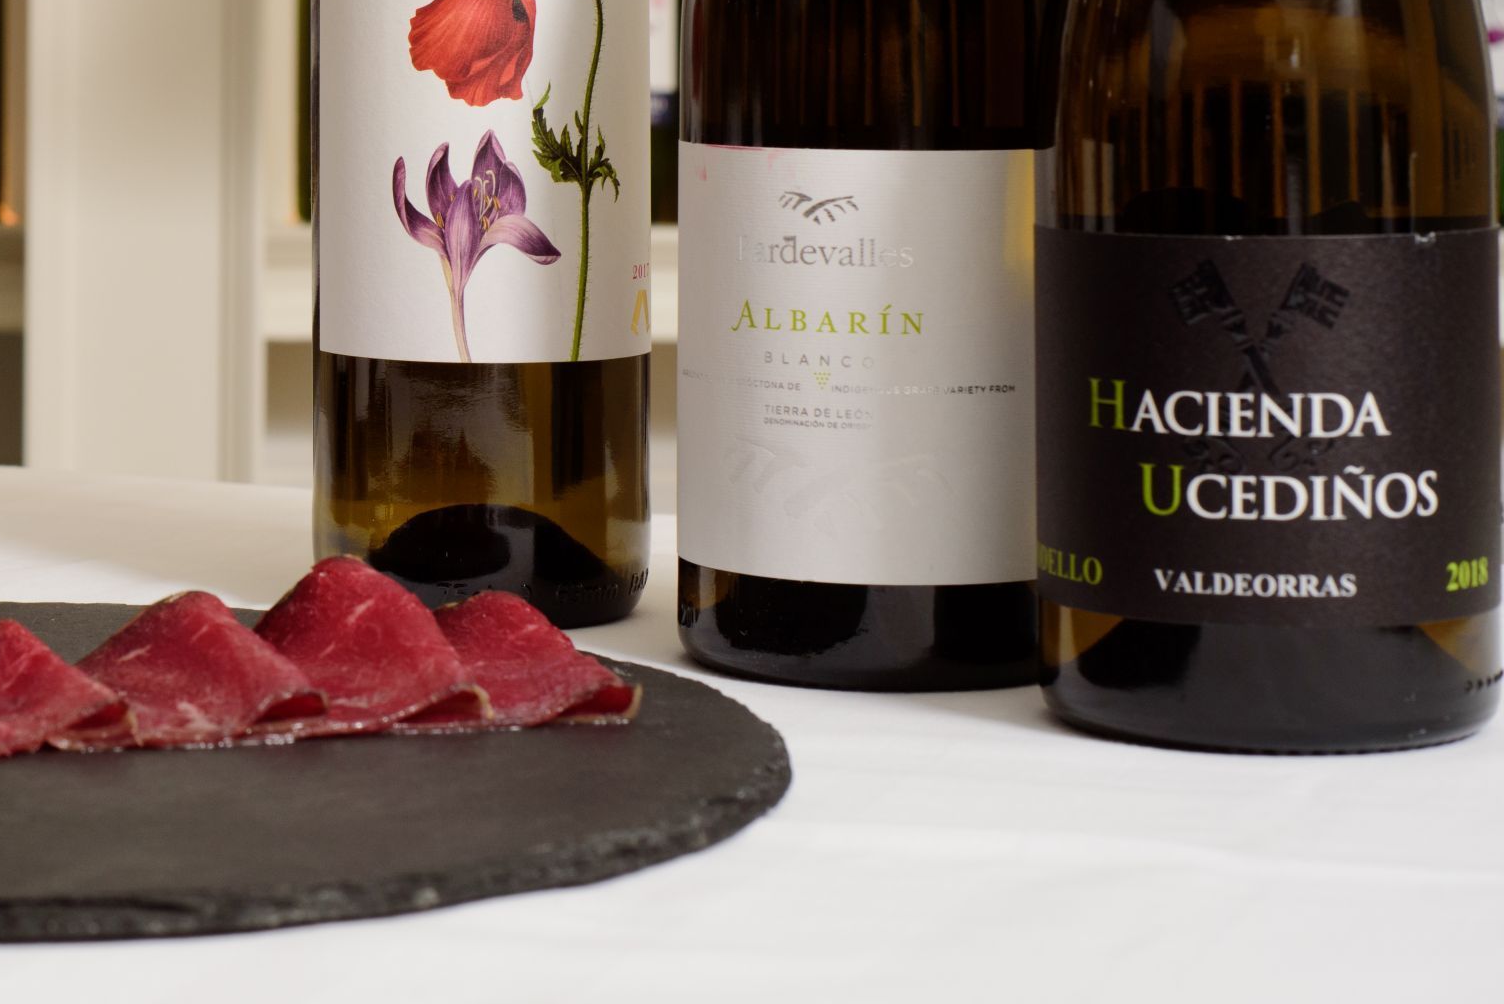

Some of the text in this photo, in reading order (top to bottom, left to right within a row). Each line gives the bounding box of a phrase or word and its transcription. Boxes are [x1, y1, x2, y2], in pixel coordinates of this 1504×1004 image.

[731, 299, 925, 336] ALBARÍN
[763, 350, 875, 370] BLANCO
[943, 385, 986, 396] VARIETY
[989, 384, 1016, 394] FROM
[763, 404, 809, 417] TIERRA
[814, 407, 831, 419] DE
[1088, 377, 1392, 438] HACIENDA
[827, 420, 838, 430] DE
[1138, 463, 1439, 522] UCEDIÑOS
[1153, 568, 1357, 598] VALDEORRAS
[1445, 555, 1489, 593] 2018
